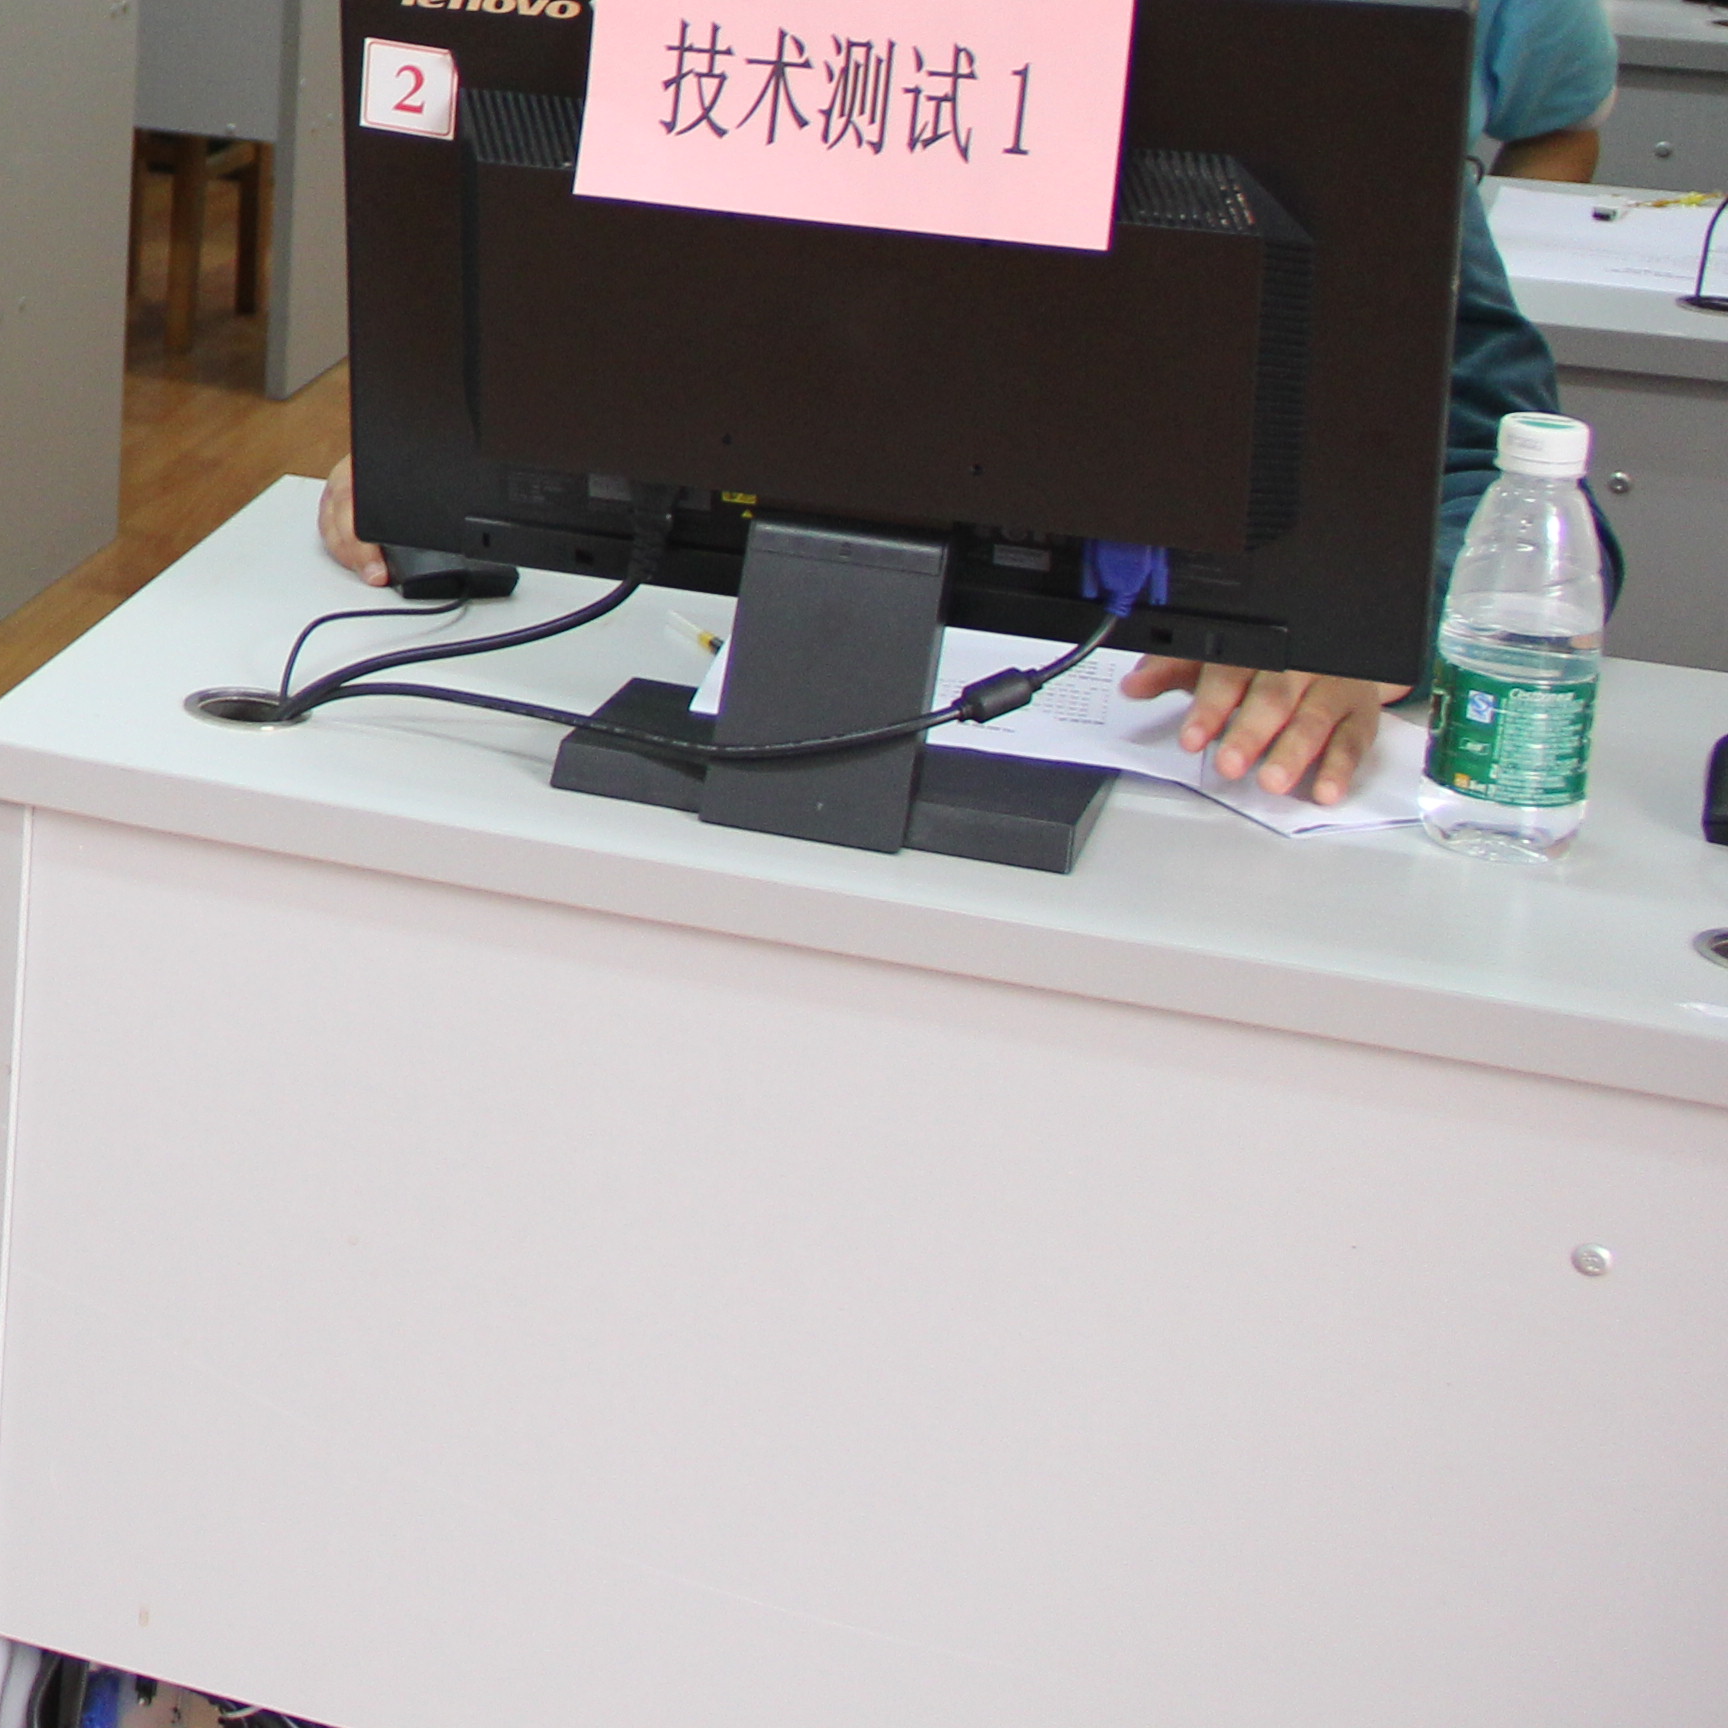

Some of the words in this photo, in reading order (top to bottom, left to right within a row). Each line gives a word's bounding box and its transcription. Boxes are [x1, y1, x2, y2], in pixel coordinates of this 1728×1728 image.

[393, 65, 426, 115] 2
[660, 18, 1034, 164] 技术测试1
